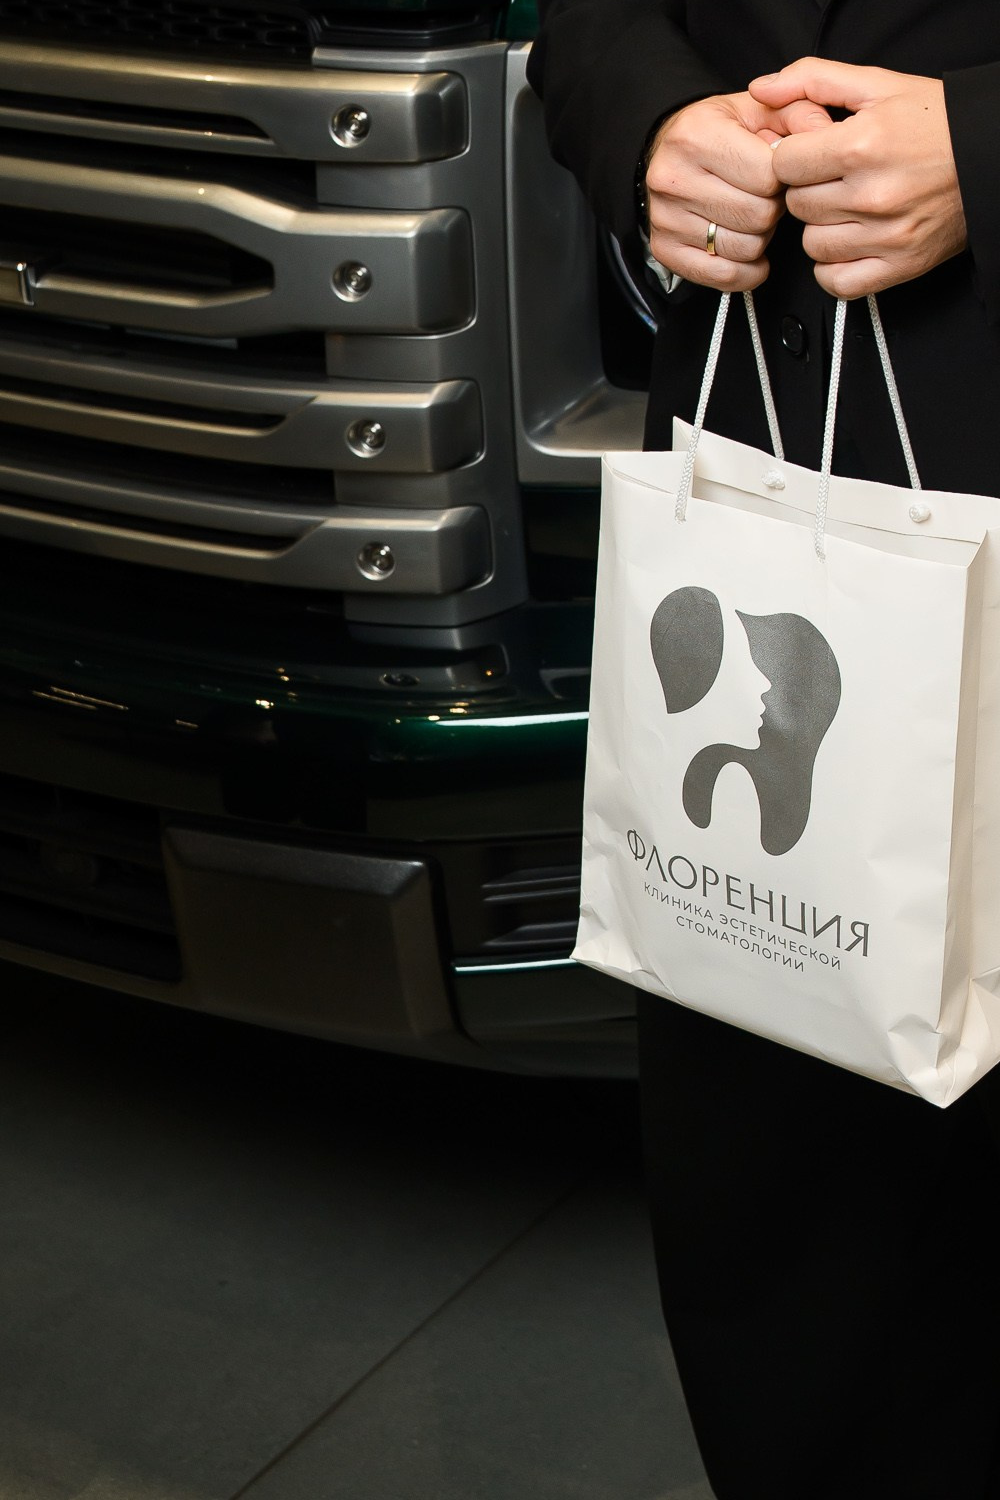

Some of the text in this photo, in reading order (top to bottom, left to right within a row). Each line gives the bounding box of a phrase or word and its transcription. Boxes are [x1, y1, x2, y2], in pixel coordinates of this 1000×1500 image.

[626, 828, 870, 958] ФЛОРЕНЦИЯ
[644, 881, 841, 970] КЛИНИКА ЭСТЕТИЧЕСКОЙ
[676, 915, 804, 973] СТОМАТОЛОГИИ
